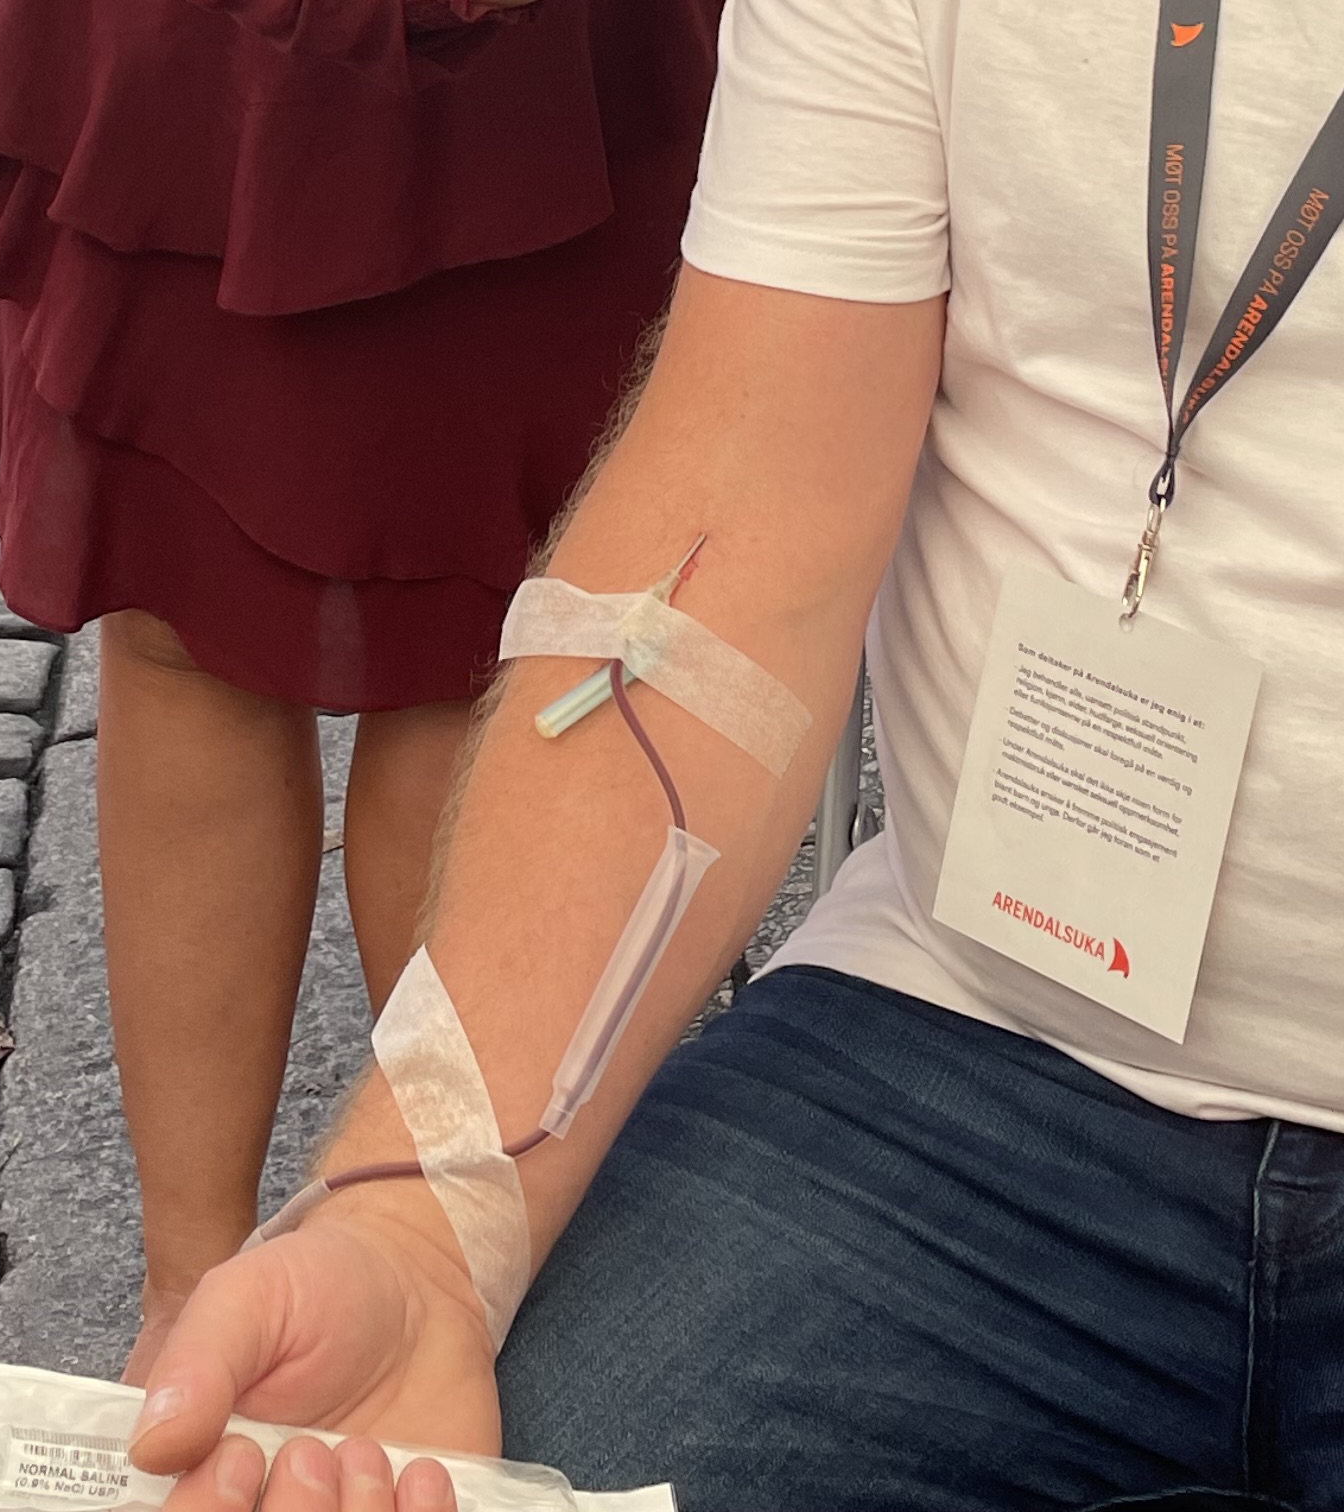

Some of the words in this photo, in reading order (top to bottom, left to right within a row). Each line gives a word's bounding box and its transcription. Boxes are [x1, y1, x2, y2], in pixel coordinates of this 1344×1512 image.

[1164, 144, 1184, 185] MØT
[1161, 189, 1182, 230] OSS
[1296, 187, 1330, 233] MØT
[1273, 229, 1306, 271] OSS
[992, 891, 1105, 962] ARENDALSUKA
[15, 1477, 50, 1491] (0.9%
[88, 1485, 120, 1500] USP)
[19, 1463, 76, 1480] NORMAL
[81, 1470, 129, 1487] SALINE
